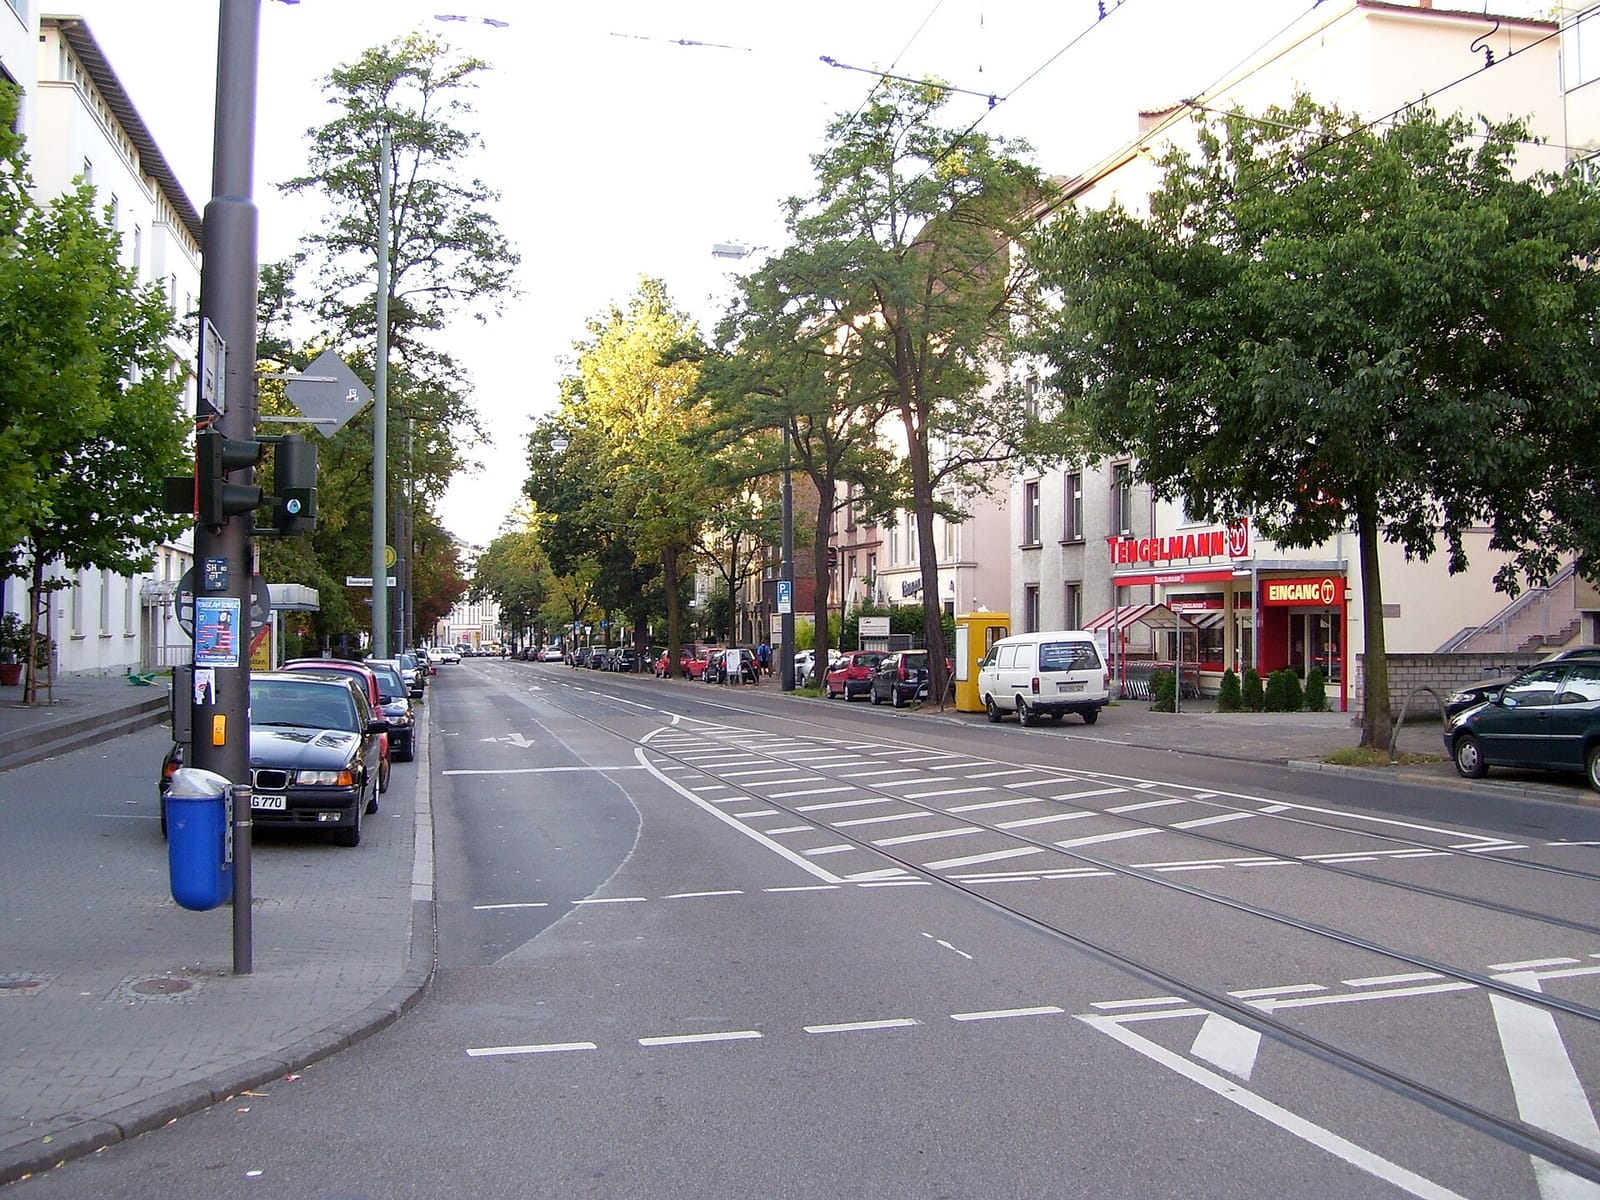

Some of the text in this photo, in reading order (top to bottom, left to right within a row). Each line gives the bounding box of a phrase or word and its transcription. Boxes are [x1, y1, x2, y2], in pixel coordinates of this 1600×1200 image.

[1106, 531, 1224, 564] TENGELMANN
[779, 583, 786, 594] P
[1269, 583, 1320, 601] EINGANG
[252, 796, 282, 808] G 770
